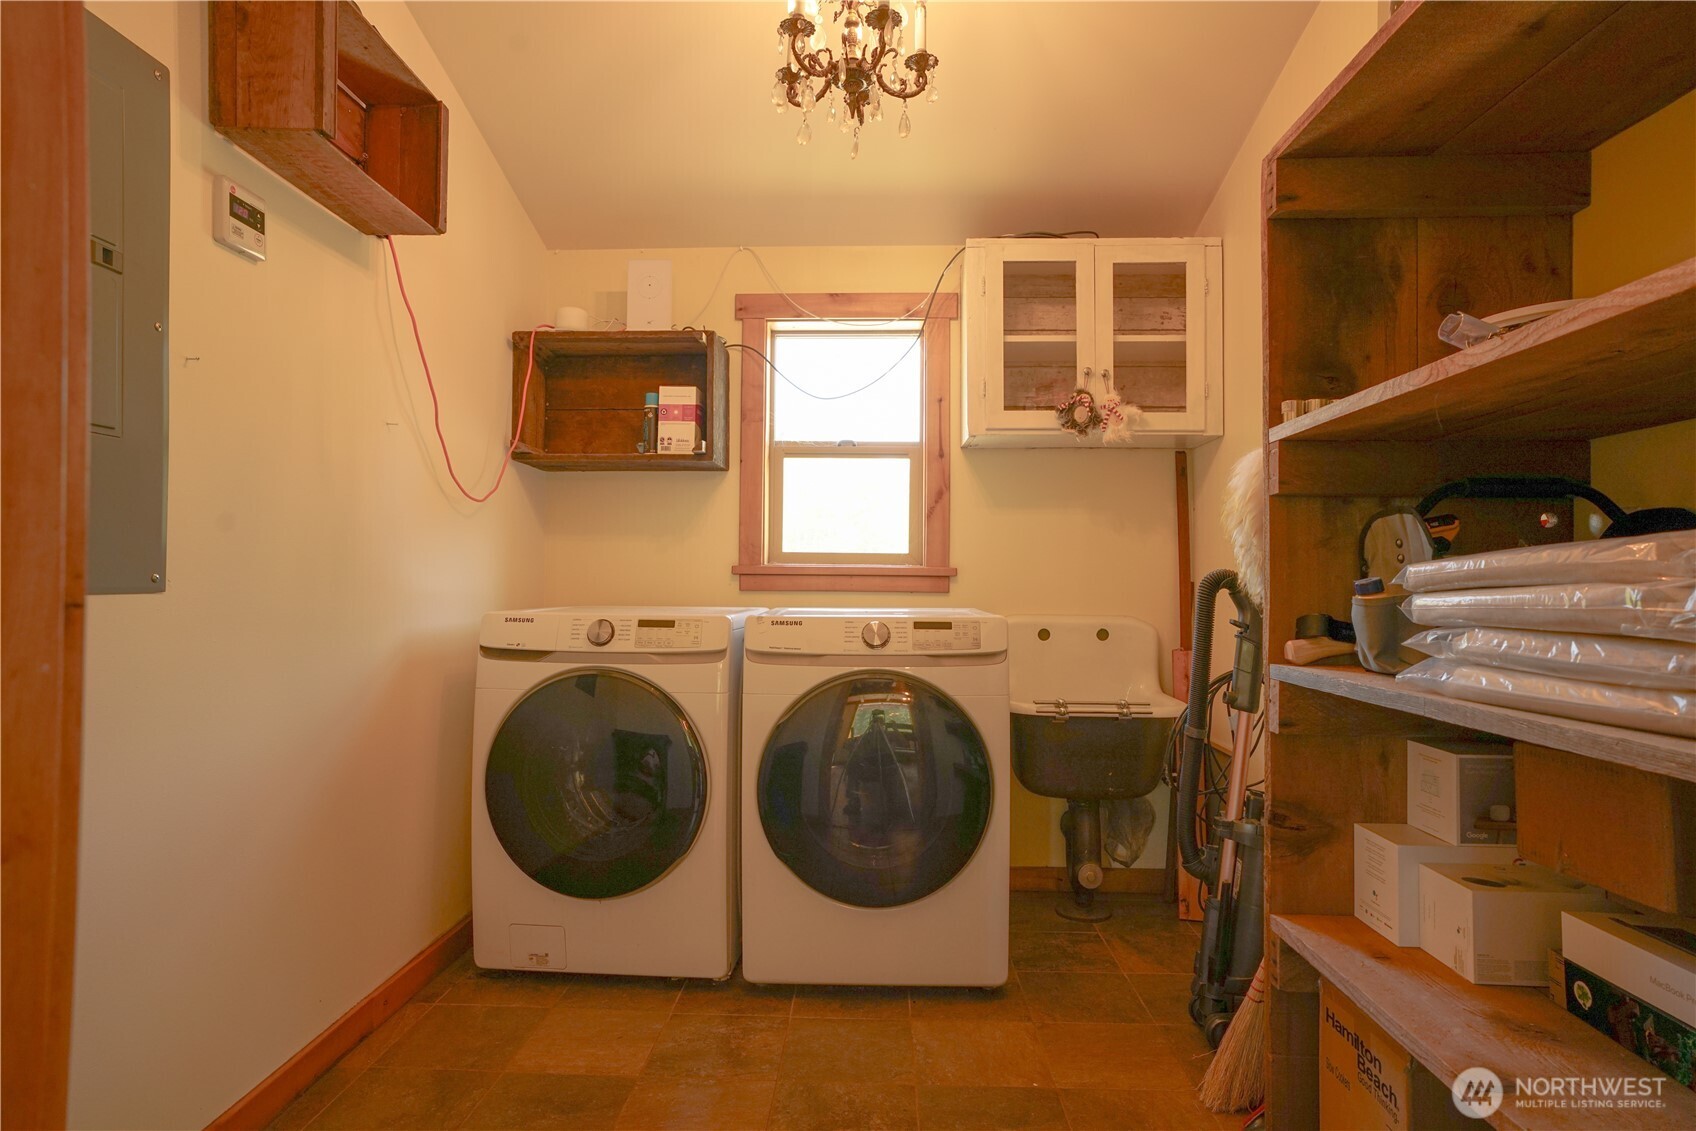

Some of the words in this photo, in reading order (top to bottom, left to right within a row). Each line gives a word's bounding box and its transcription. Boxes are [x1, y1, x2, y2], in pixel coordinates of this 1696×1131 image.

[1466, 831, 1489, 840] Google
[1649, 975, 1685, 1000] MacBook
[1325, 1006, 1382, 1075] Hamilton
